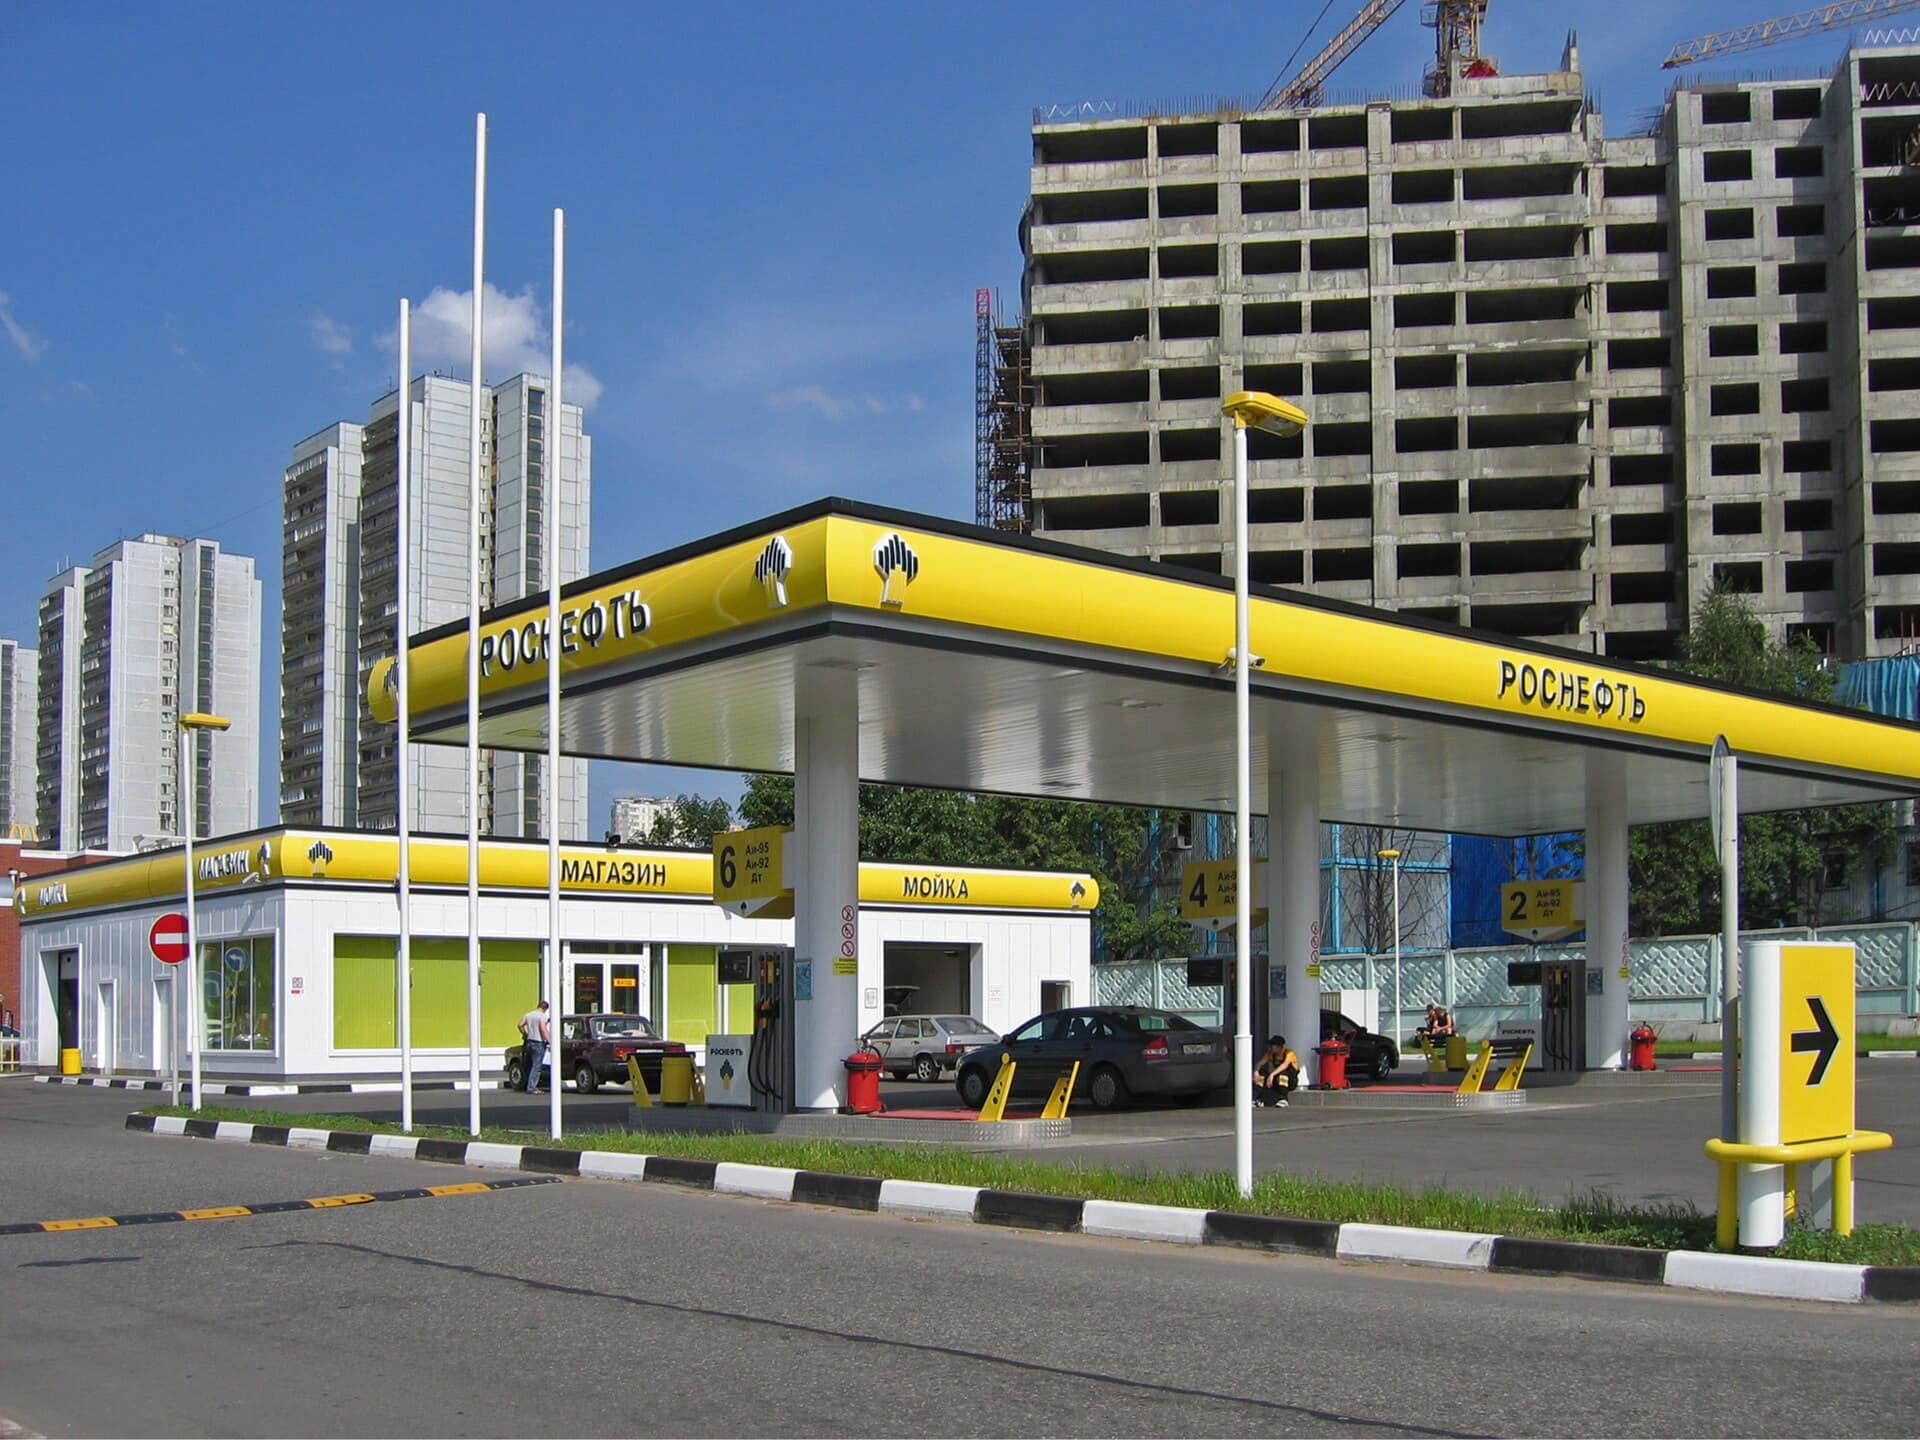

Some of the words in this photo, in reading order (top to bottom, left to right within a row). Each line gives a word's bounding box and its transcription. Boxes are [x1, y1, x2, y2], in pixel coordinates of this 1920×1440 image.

[1497, 659, 1646, 722] РОСНЕФТЬ
[198, 850, 250, 882] МАГАЗИН
[560, 858, 667, 887] МАГАЗИН
[720, 845, 737, 889] 6
[902, 873, 969, 899] МОЙКА
[1189, 872, 1208, 908] 4
[1509, 891, 1528, 921] 2
[710, 1047, 744, 1056] РОСНЕФТЬ
